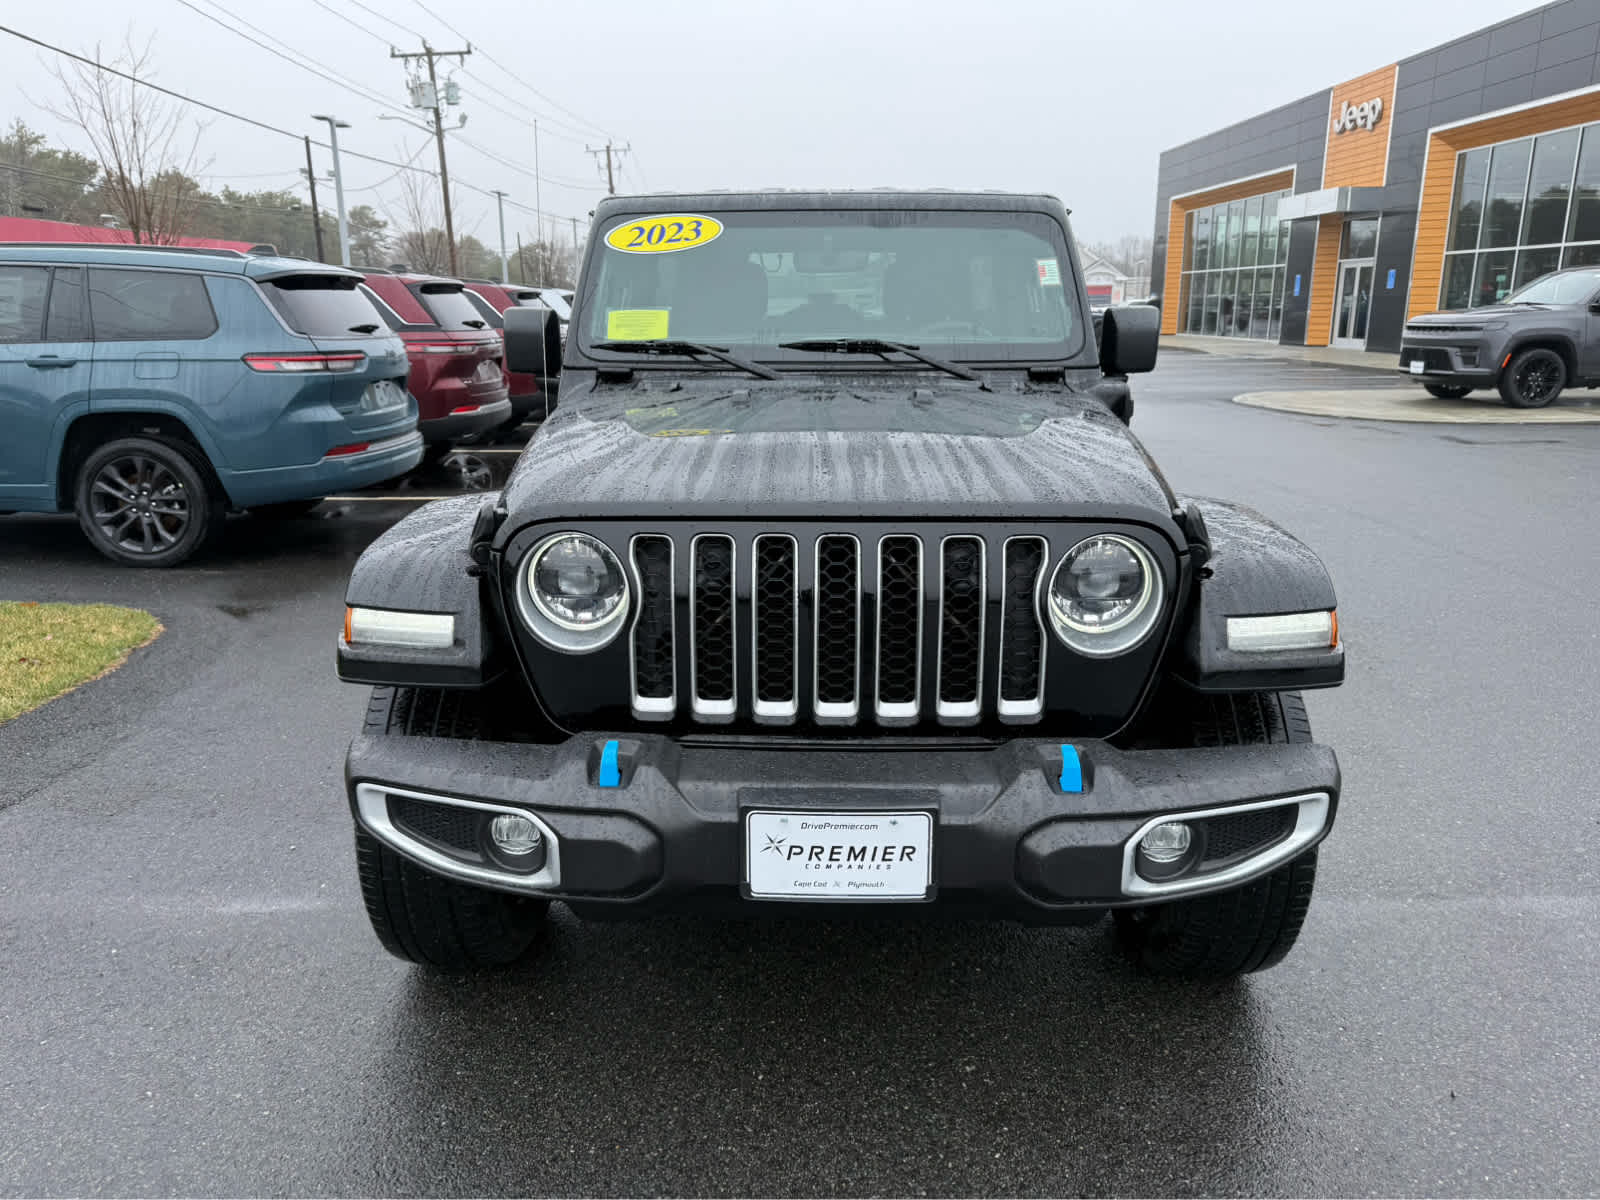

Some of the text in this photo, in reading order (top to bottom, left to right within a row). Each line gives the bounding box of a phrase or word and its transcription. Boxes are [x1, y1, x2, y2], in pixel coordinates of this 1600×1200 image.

[1334, 97, 1382, 134] Jeep
[626, 220, 703, 248] 2023
[800, 822, 879, 831] DrivePremier.com
[786, 845, 916, 862] PREMIER
[793, 880, 885, 889] Cape Cod Plymouth
